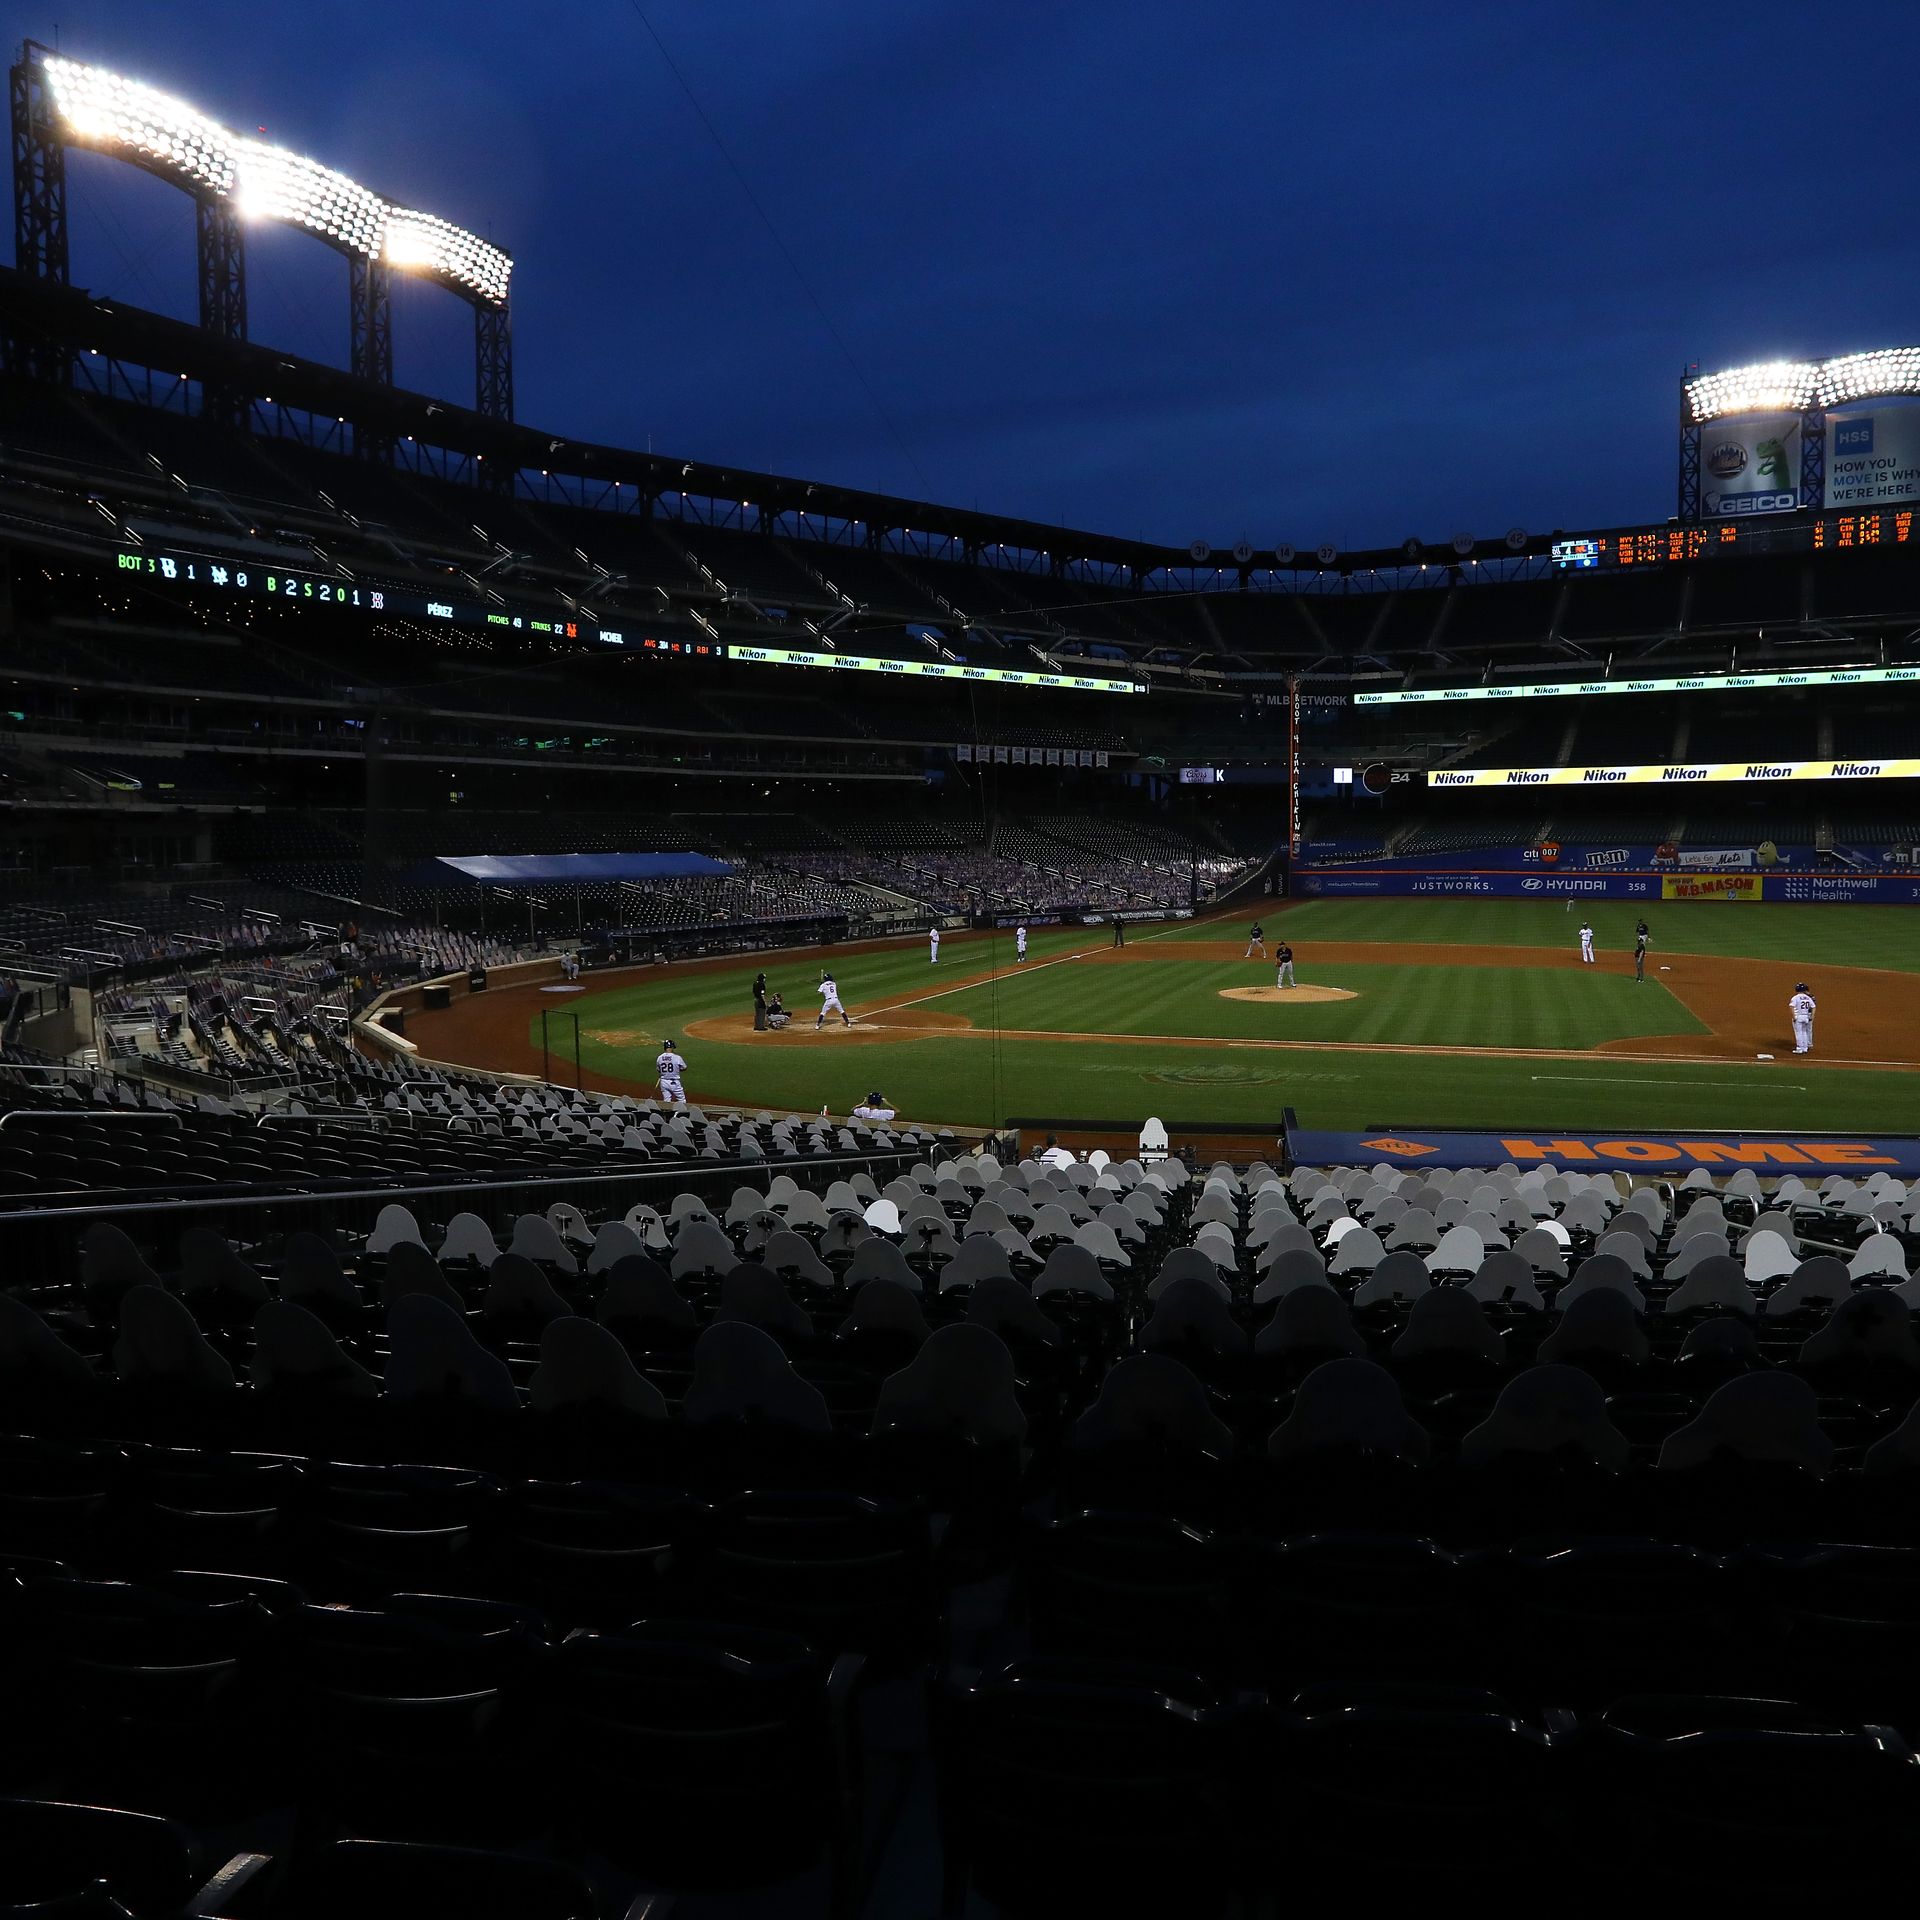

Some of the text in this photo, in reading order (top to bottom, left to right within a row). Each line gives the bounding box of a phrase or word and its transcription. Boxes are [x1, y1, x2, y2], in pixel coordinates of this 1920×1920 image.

[1839, 430, 1870, 444] HSS
[1834, 458, 1897, 473] HOW YOU
[1834, 473, 1871, 486] MOVE
[1875, 472, 1888, 482] IS
[1833, 485, 1916, 500] WE'RE HERE.
[1719, 494, 1794, 514] GEICO
[1510, 532, 1524, 545] 42
[1669, 532, 1684, 540] CLE
[1838, 539, 1854, 547] ATL
[1195, 545, 1206, 556] 31
[1320, 549, 1333, 560] 37
[1669, 552, 1684, 560] DET
[118, 553, 143, 571] BOT
[147, 558, 156, 573] 3
[187, 564, 196, 580] 1
[236, 572, 248, 588] 0
[267, 576, 277, 592] B
[285, 579, 298, 597] 2
[303, 582, 313, 597] S
[319, 584, 331, 602] 2
[352, 589, 360, 606] 1
[426, 602, 454, 619] PÉREZ
[487, 614, 510, 626] PITCHES
[530, 620, 552, 632] STRIKES
[554, 623, 564, 635] 22
[643, 639, 657, 649] AVG
[696, 645, 709, 655] RBI
[738, 648, 1128, 691] Nikon Nikon Nikon Nikon Nikon Nikon Nikon Nikon Nikon Nikon
[1358, 670, 1916, 703] Nikon Nikon Nikon Nikon Nikon Nikon Nikon Nikon Nikon Nikon Nikon Nikon
[1266, 695, 1348, 706] MLB ETWORK
[1215, 769, 1225, 782] K
[1390, 772, 1411, 783] 24
[1434, 763, 1881, 784] Nikon Nikon Nikon Nikon Nikon Nikon
[1523, 850, 1539, 859] citi
[1412, 881, 1494, 890] JUSTWORKS.
[1546, 879, 1607, 890] HYUNDAI
[1628, 882, 1647, 892] 358
[1812, 878, 1878, 889] Northwell
[1812, 890, 1852, 901] Health
[1912, 888, 1920, 898] 3
[1800, 1001, 1810, 1010] 20
[660, 1062, 674, 1073] 28
[1500, 1139, 1901, 1164] HOME
